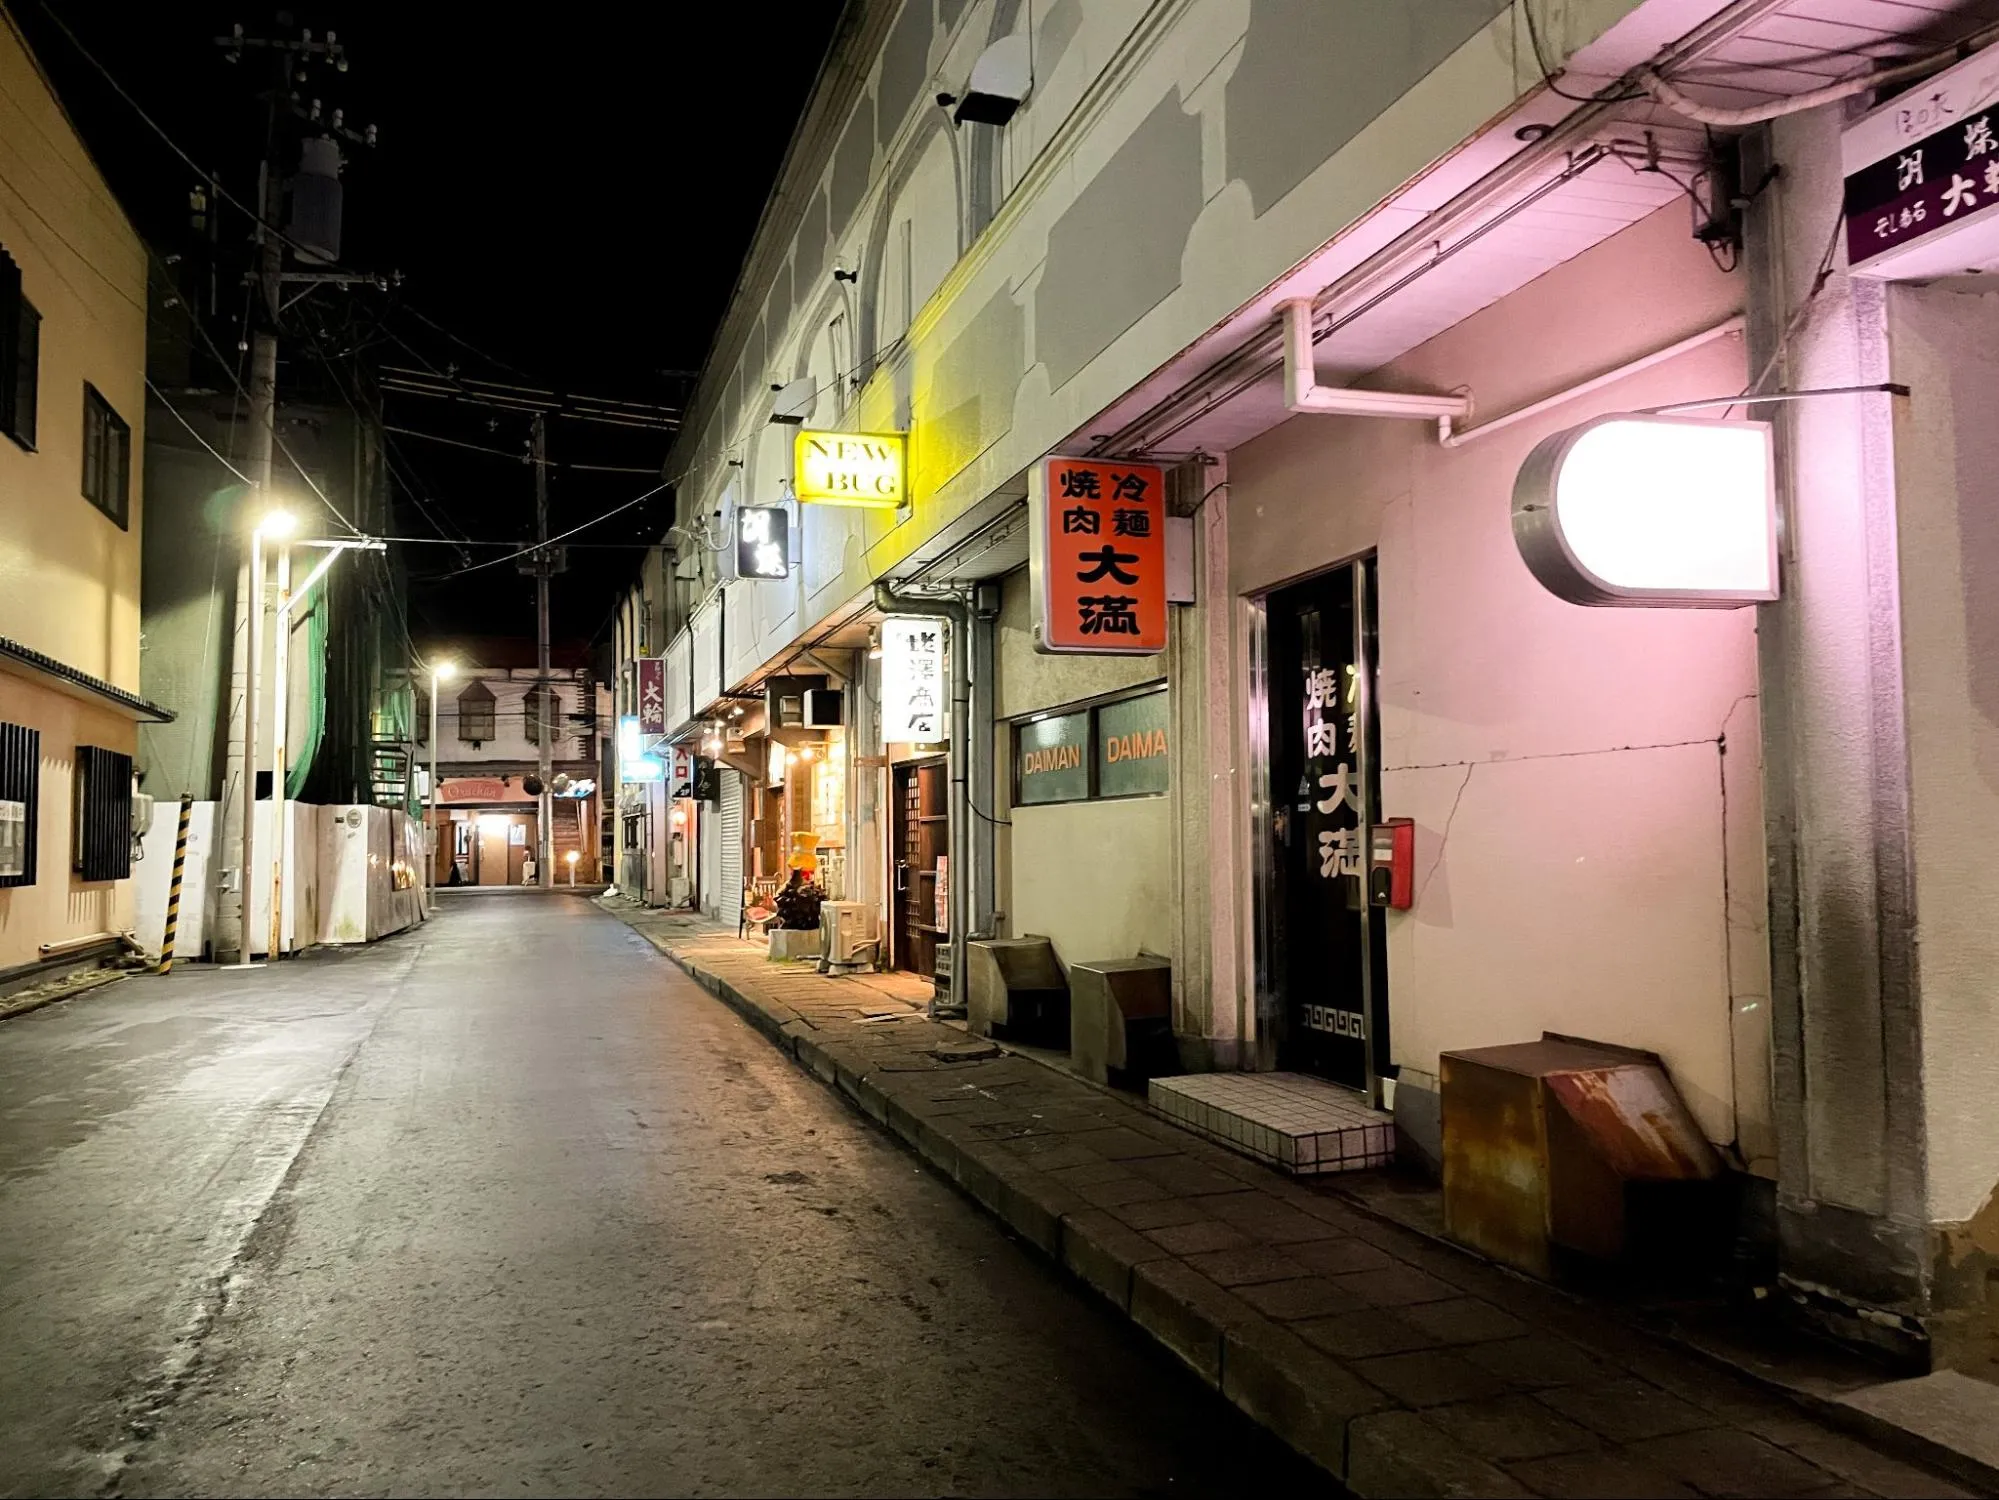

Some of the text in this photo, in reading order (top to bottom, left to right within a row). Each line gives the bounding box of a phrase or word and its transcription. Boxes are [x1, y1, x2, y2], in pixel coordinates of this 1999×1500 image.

[804, 439, 894, 461] NEW
[826, 472, 895, 495] BUG
[1060, 469, 1101, 535] 焼肉
[1077, 545, 1141, 635] 大満
[1306, 668, 1337, 759] 焼肉
[1025, 744, 1080, 775] DAIMAN
[1106, 728, 1167, 764] DAIMA
[675, 748, 688, 778] 入口
